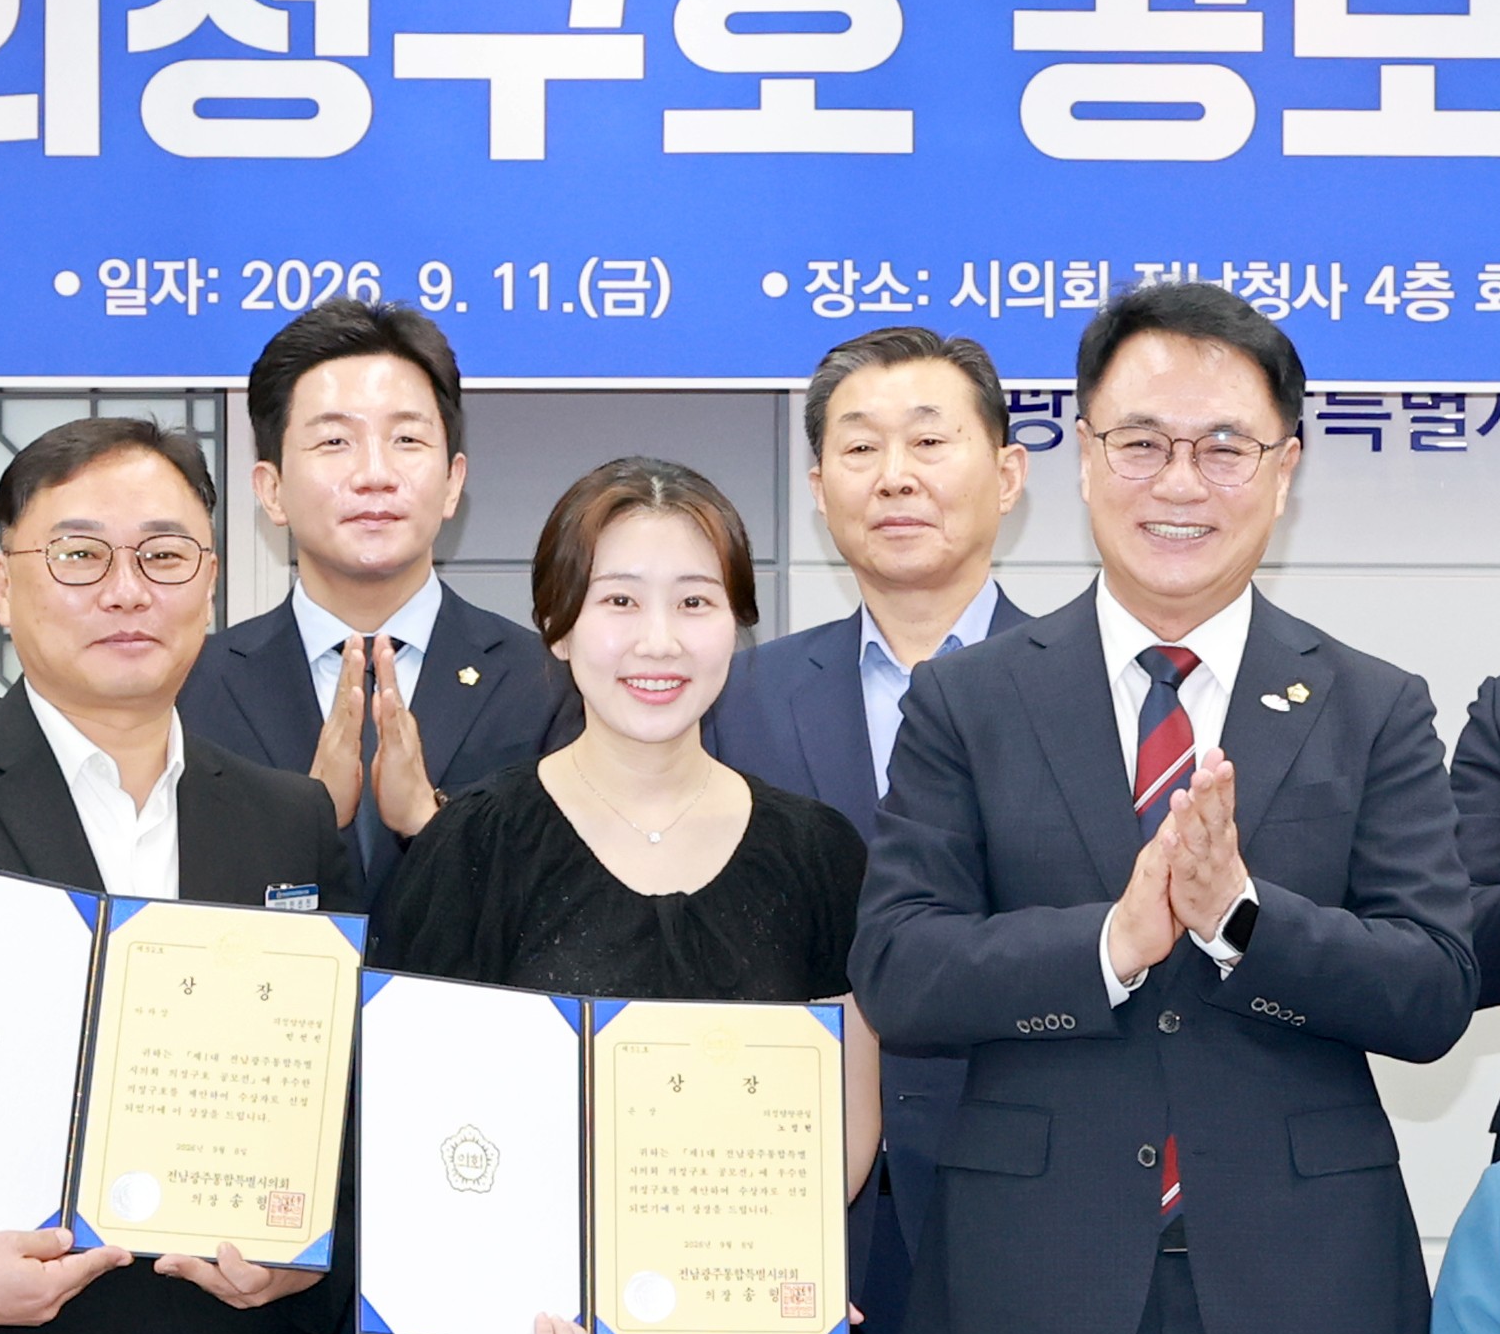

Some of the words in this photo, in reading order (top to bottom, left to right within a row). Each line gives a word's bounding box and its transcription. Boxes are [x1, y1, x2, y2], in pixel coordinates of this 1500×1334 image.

[98, 257, 219, 316] 일자:
[418, 260, 468, 313] 9.
[493, 256, 671, 319] 11.(금)
[804, 259, 929, 319] 장소:
[949, 260, 1110, 319] 시의회
[1364, 261, 1455, 322] 4층
